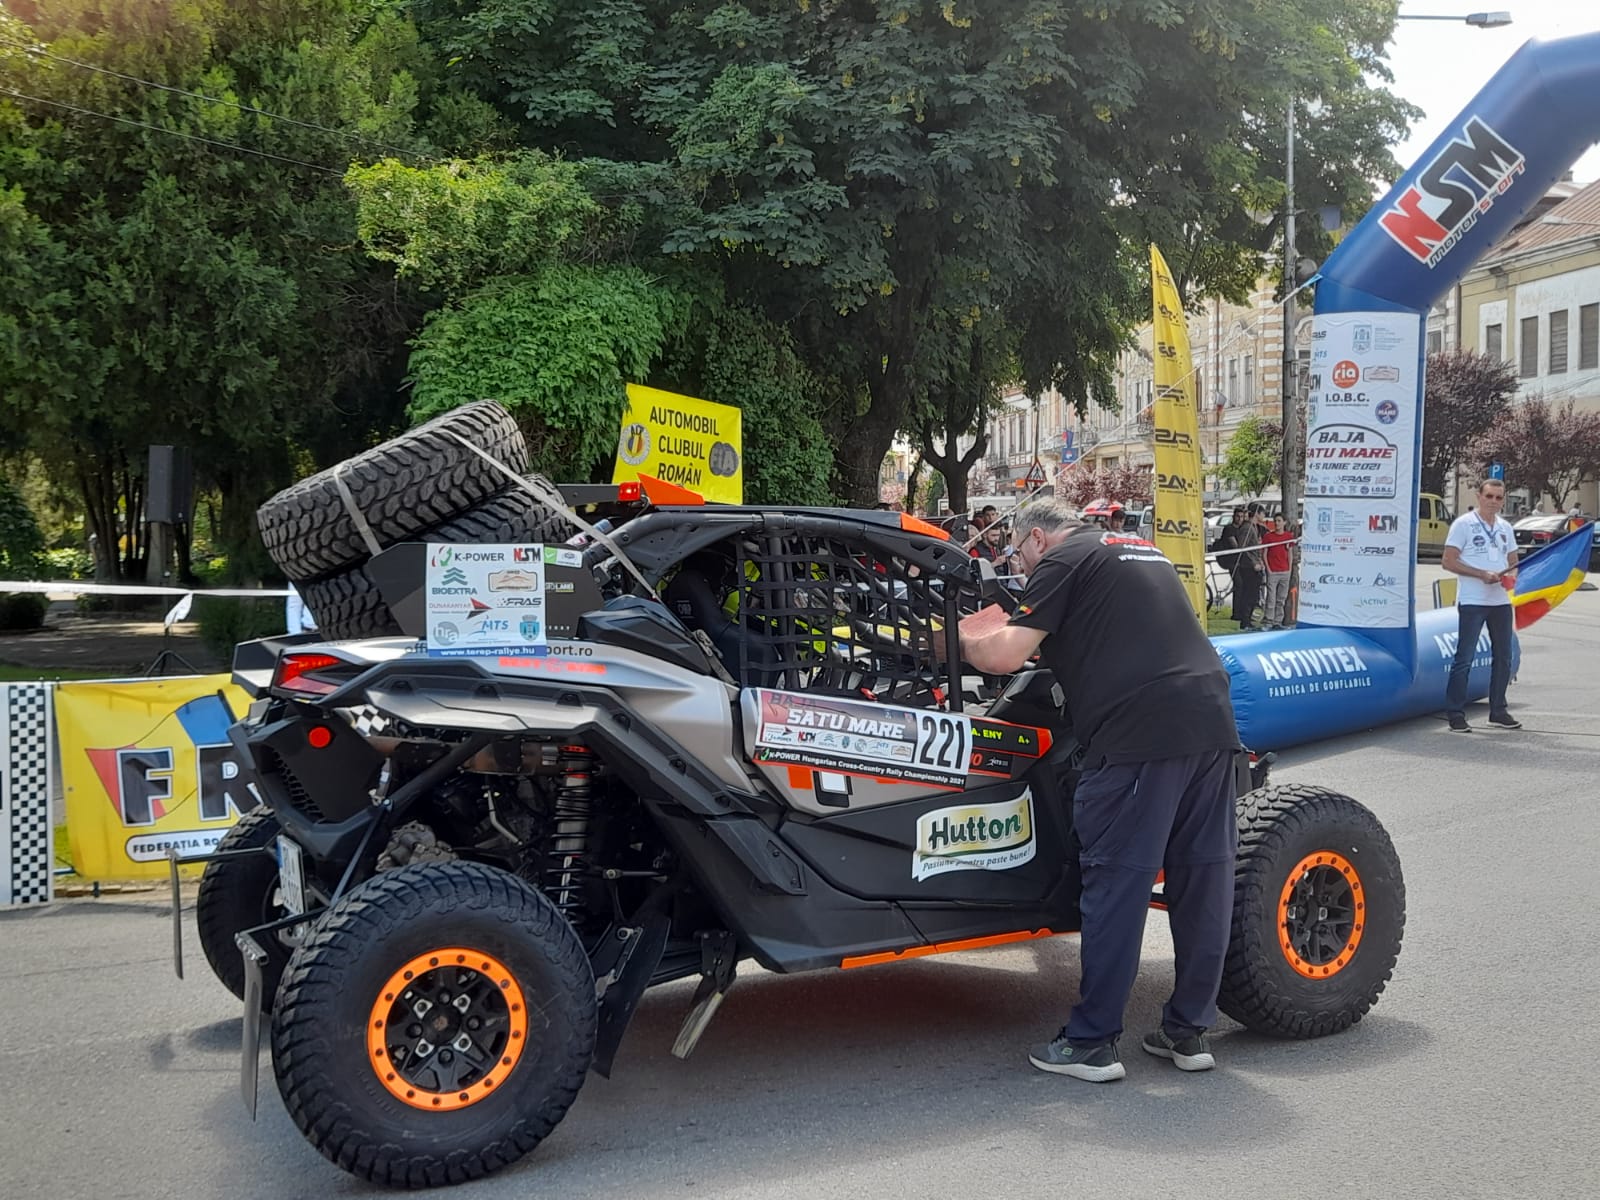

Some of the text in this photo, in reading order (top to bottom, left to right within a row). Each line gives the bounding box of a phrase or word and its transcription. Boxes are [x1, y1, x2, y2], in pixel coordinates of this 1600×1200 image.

[1334, 363, 1356, 379] ria
[1325, 393, 1370, 402] I.O.B.C.
[650, 406, 720, 436] AUTOMOBIL
[1318, 432, 1365, 443] BAJA
[658, 435, 705, 460] CLUBUL
[1338, 448, 1395, 459] MARE
[657, 462, 702, 486] ROMÂN
[454, 553, 505, 561] K-POWER
[432, 587, 477, 595] BIOEXTRA
[505, 598, 542, 606] FRAS
[482, 620, 509, 631] MTS
[441, 647, 535, 656] www.terep-rallye.hu
[1257, 646, 1367, 680] ACTIVITEX
[1269, 684, 1306, 697] FABRICA
[1309, 682, 1319, 692] DE
[787, 708, 905, 739] SATU MARE
[919, 716, 965, 769] 221
[769, 751, 800, 760] K-POWER
[802, 755, 837, 766] Hungarian
[839, 761, 884, 774] Cross-Country
[886, 767, 902, 776] Rally
[904, 770, 949, 783] Championship
[928, 814, 1021, 850] Hutton
